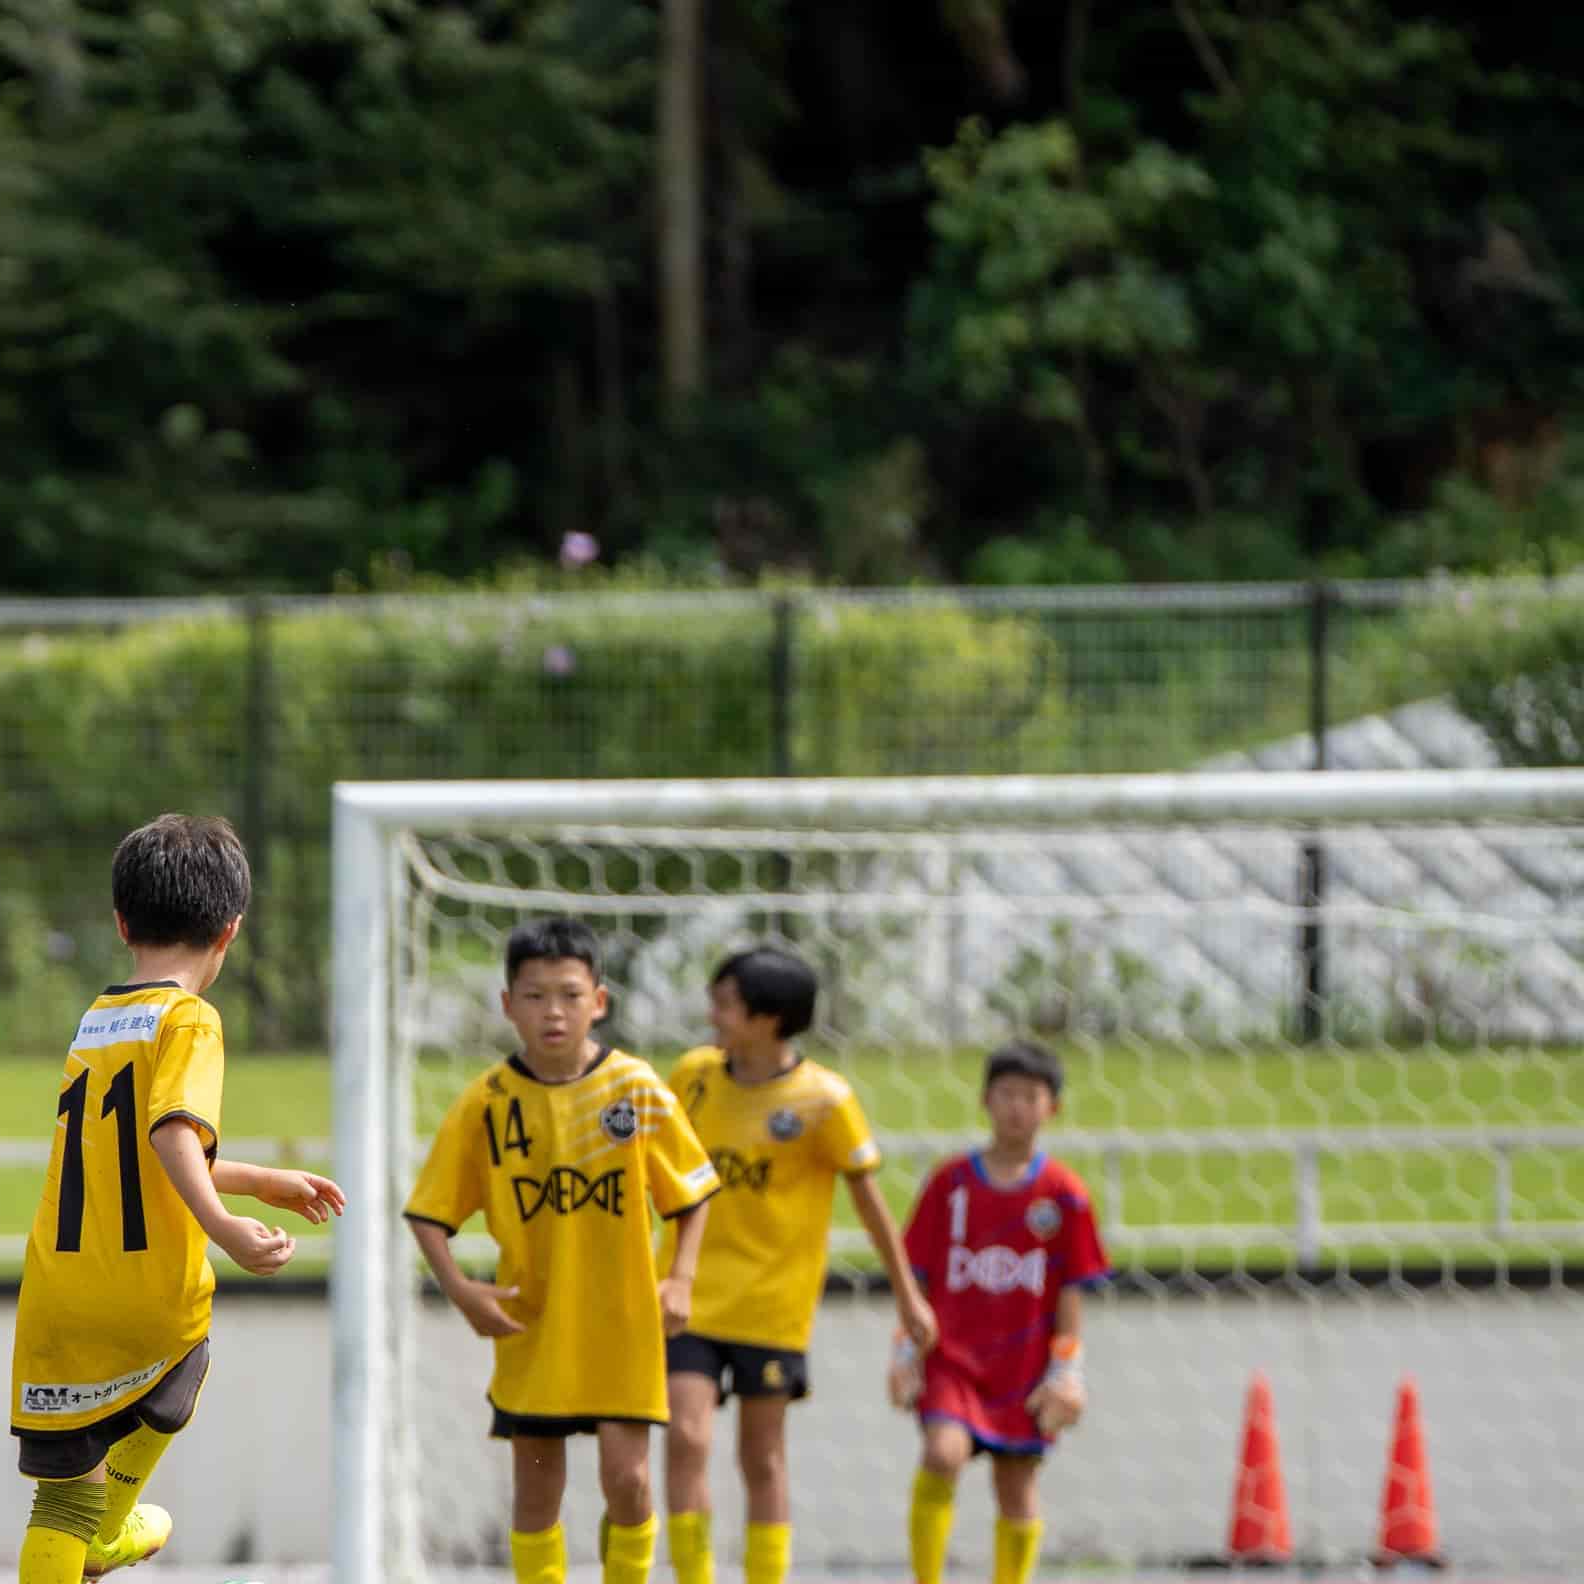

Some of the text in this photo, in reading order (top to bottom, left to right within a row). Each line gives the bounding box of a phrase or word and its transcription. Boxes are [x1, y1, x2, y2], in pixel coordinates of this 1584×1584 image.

[55, 1061, 148, 1252] 11
[483, 1096, 533, 1167] 14
[948, 1184, 969, 1242] 1
